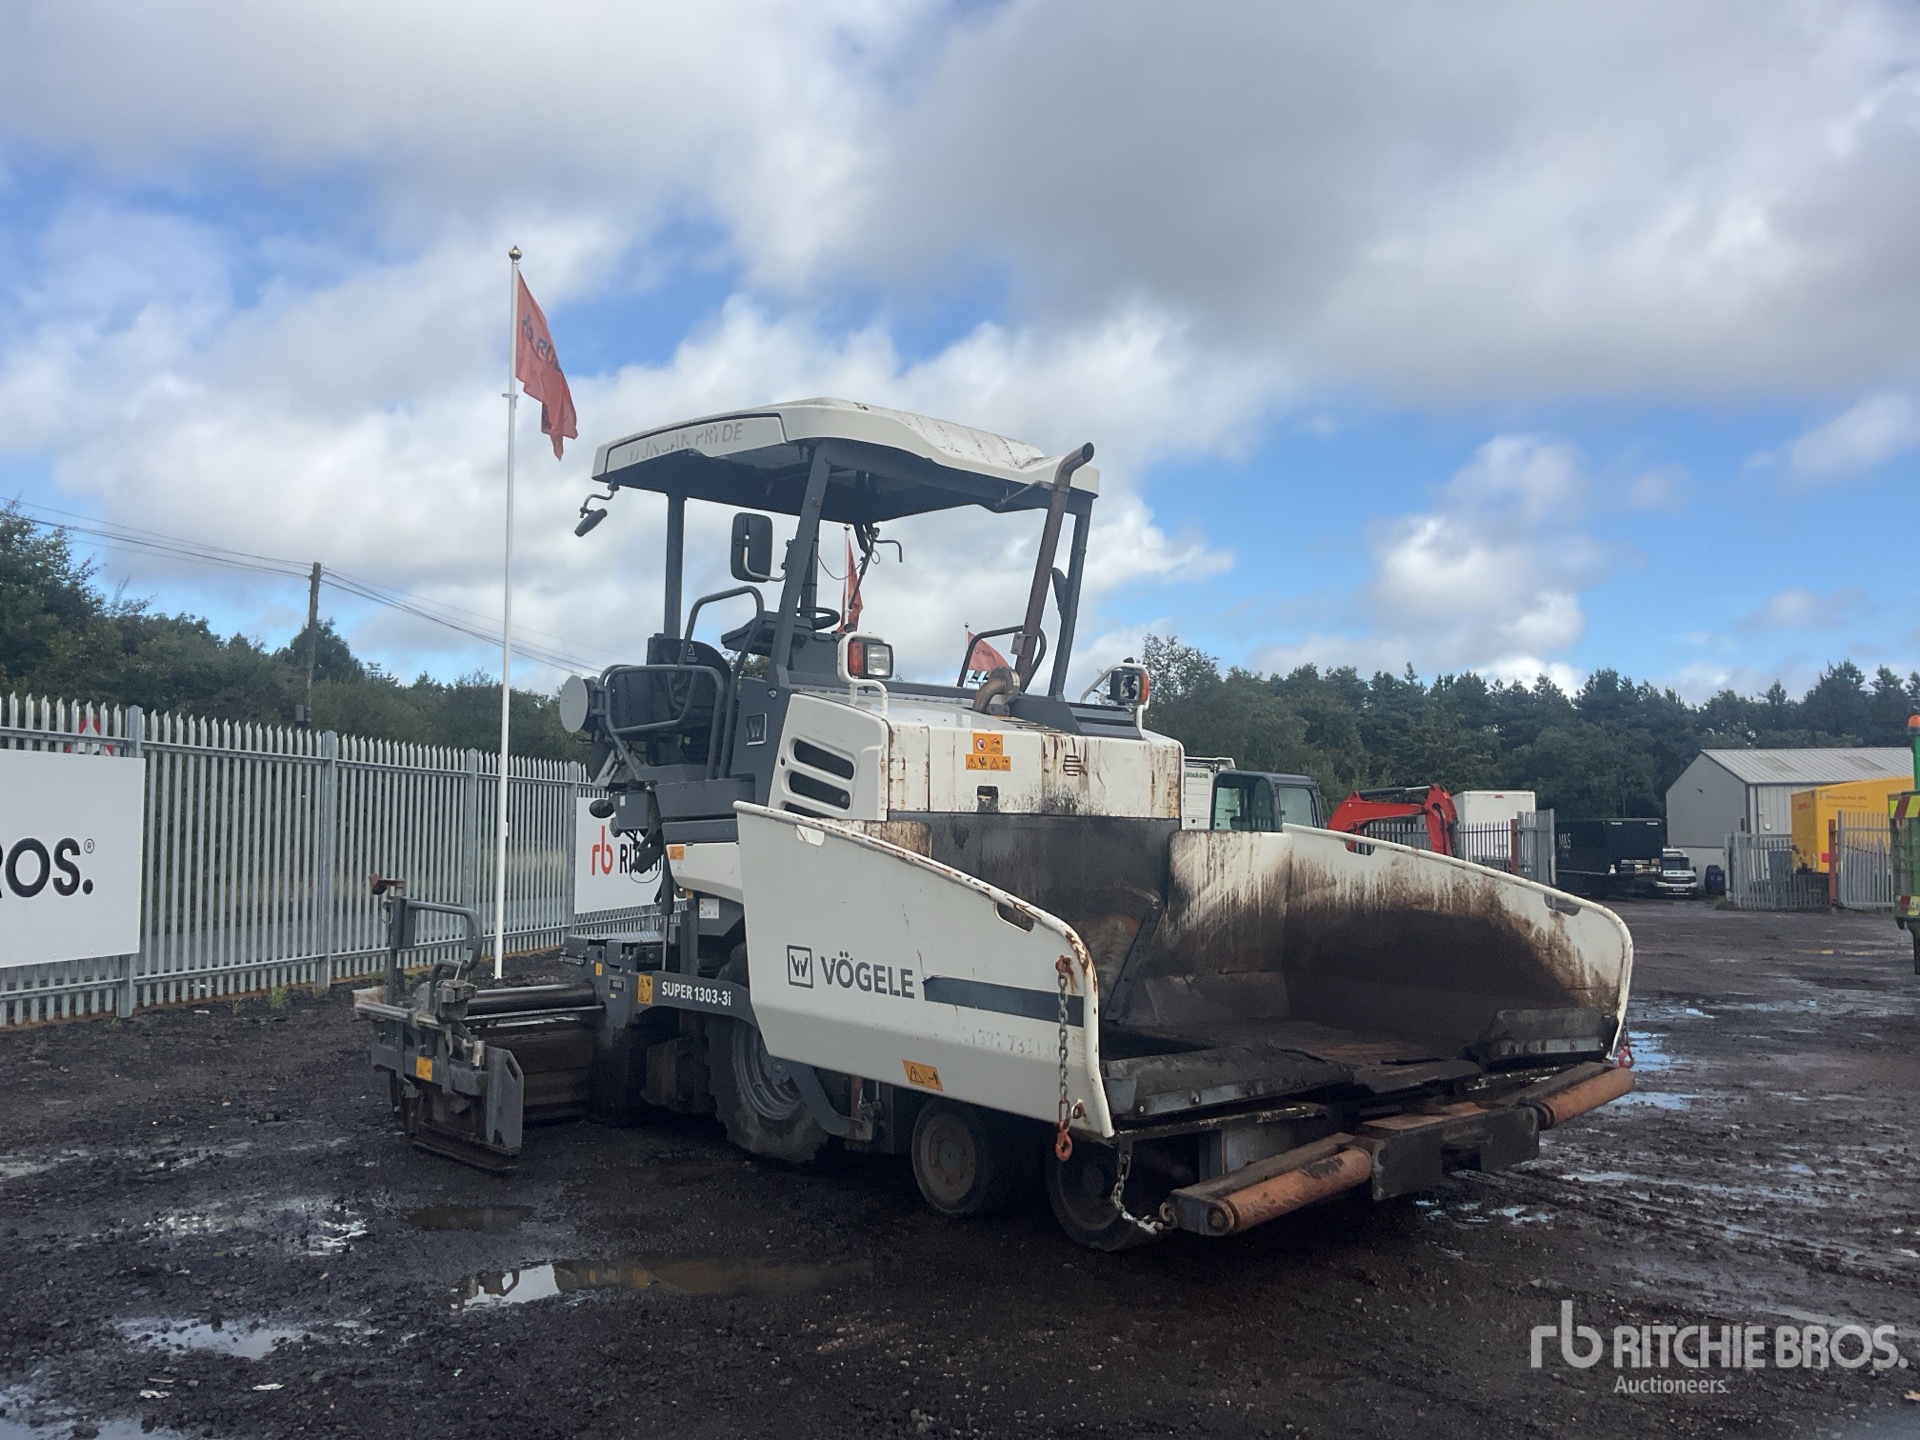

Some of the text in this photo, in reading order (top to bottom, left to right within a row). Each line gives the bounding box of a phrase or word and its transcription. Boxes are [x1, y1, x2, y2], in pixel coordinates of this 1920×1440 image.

[1558, 832, 1571, 849] M&S
[0, 837, 94, 898] OS.
[820, 950, 915, 999] VÖGELE
[661, 981, 732, 1007] SUPER 1303-3i
